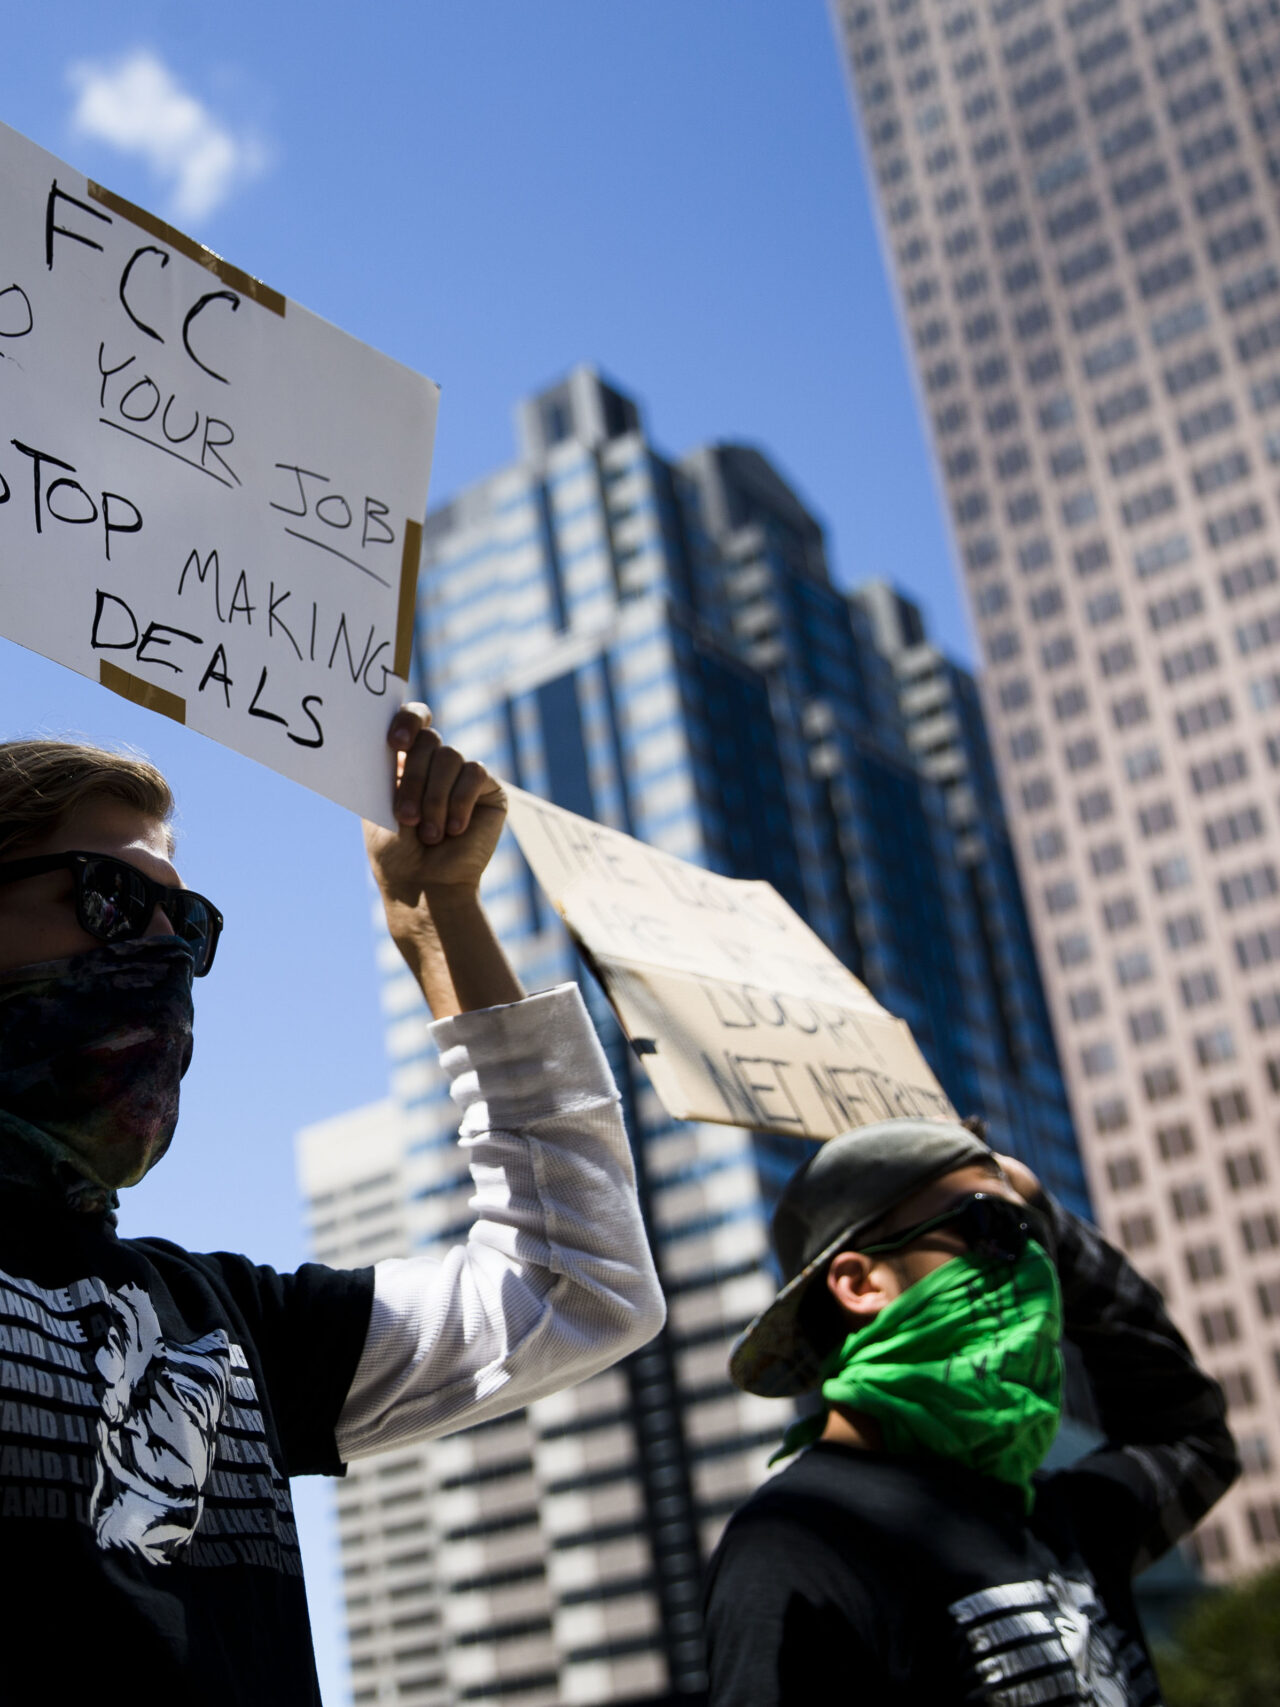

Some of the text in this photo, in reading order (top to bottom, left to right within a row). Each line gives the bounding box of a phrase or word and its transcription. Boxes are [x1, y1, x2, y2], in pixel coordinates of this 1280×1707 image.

[45, 178, 240, 385] FCC
[99, 342, 242, 487] YOUR
[269, 463, 396, 548] JOB
[91, 588, 325, 749] DEALS
[178, 548, 399, 697] MAKING
[39, 1308, 88, 1344] LIKE
[211, 1470, 256, 1499] LIKE
[218, 1508, 273, 1534] LIKE
